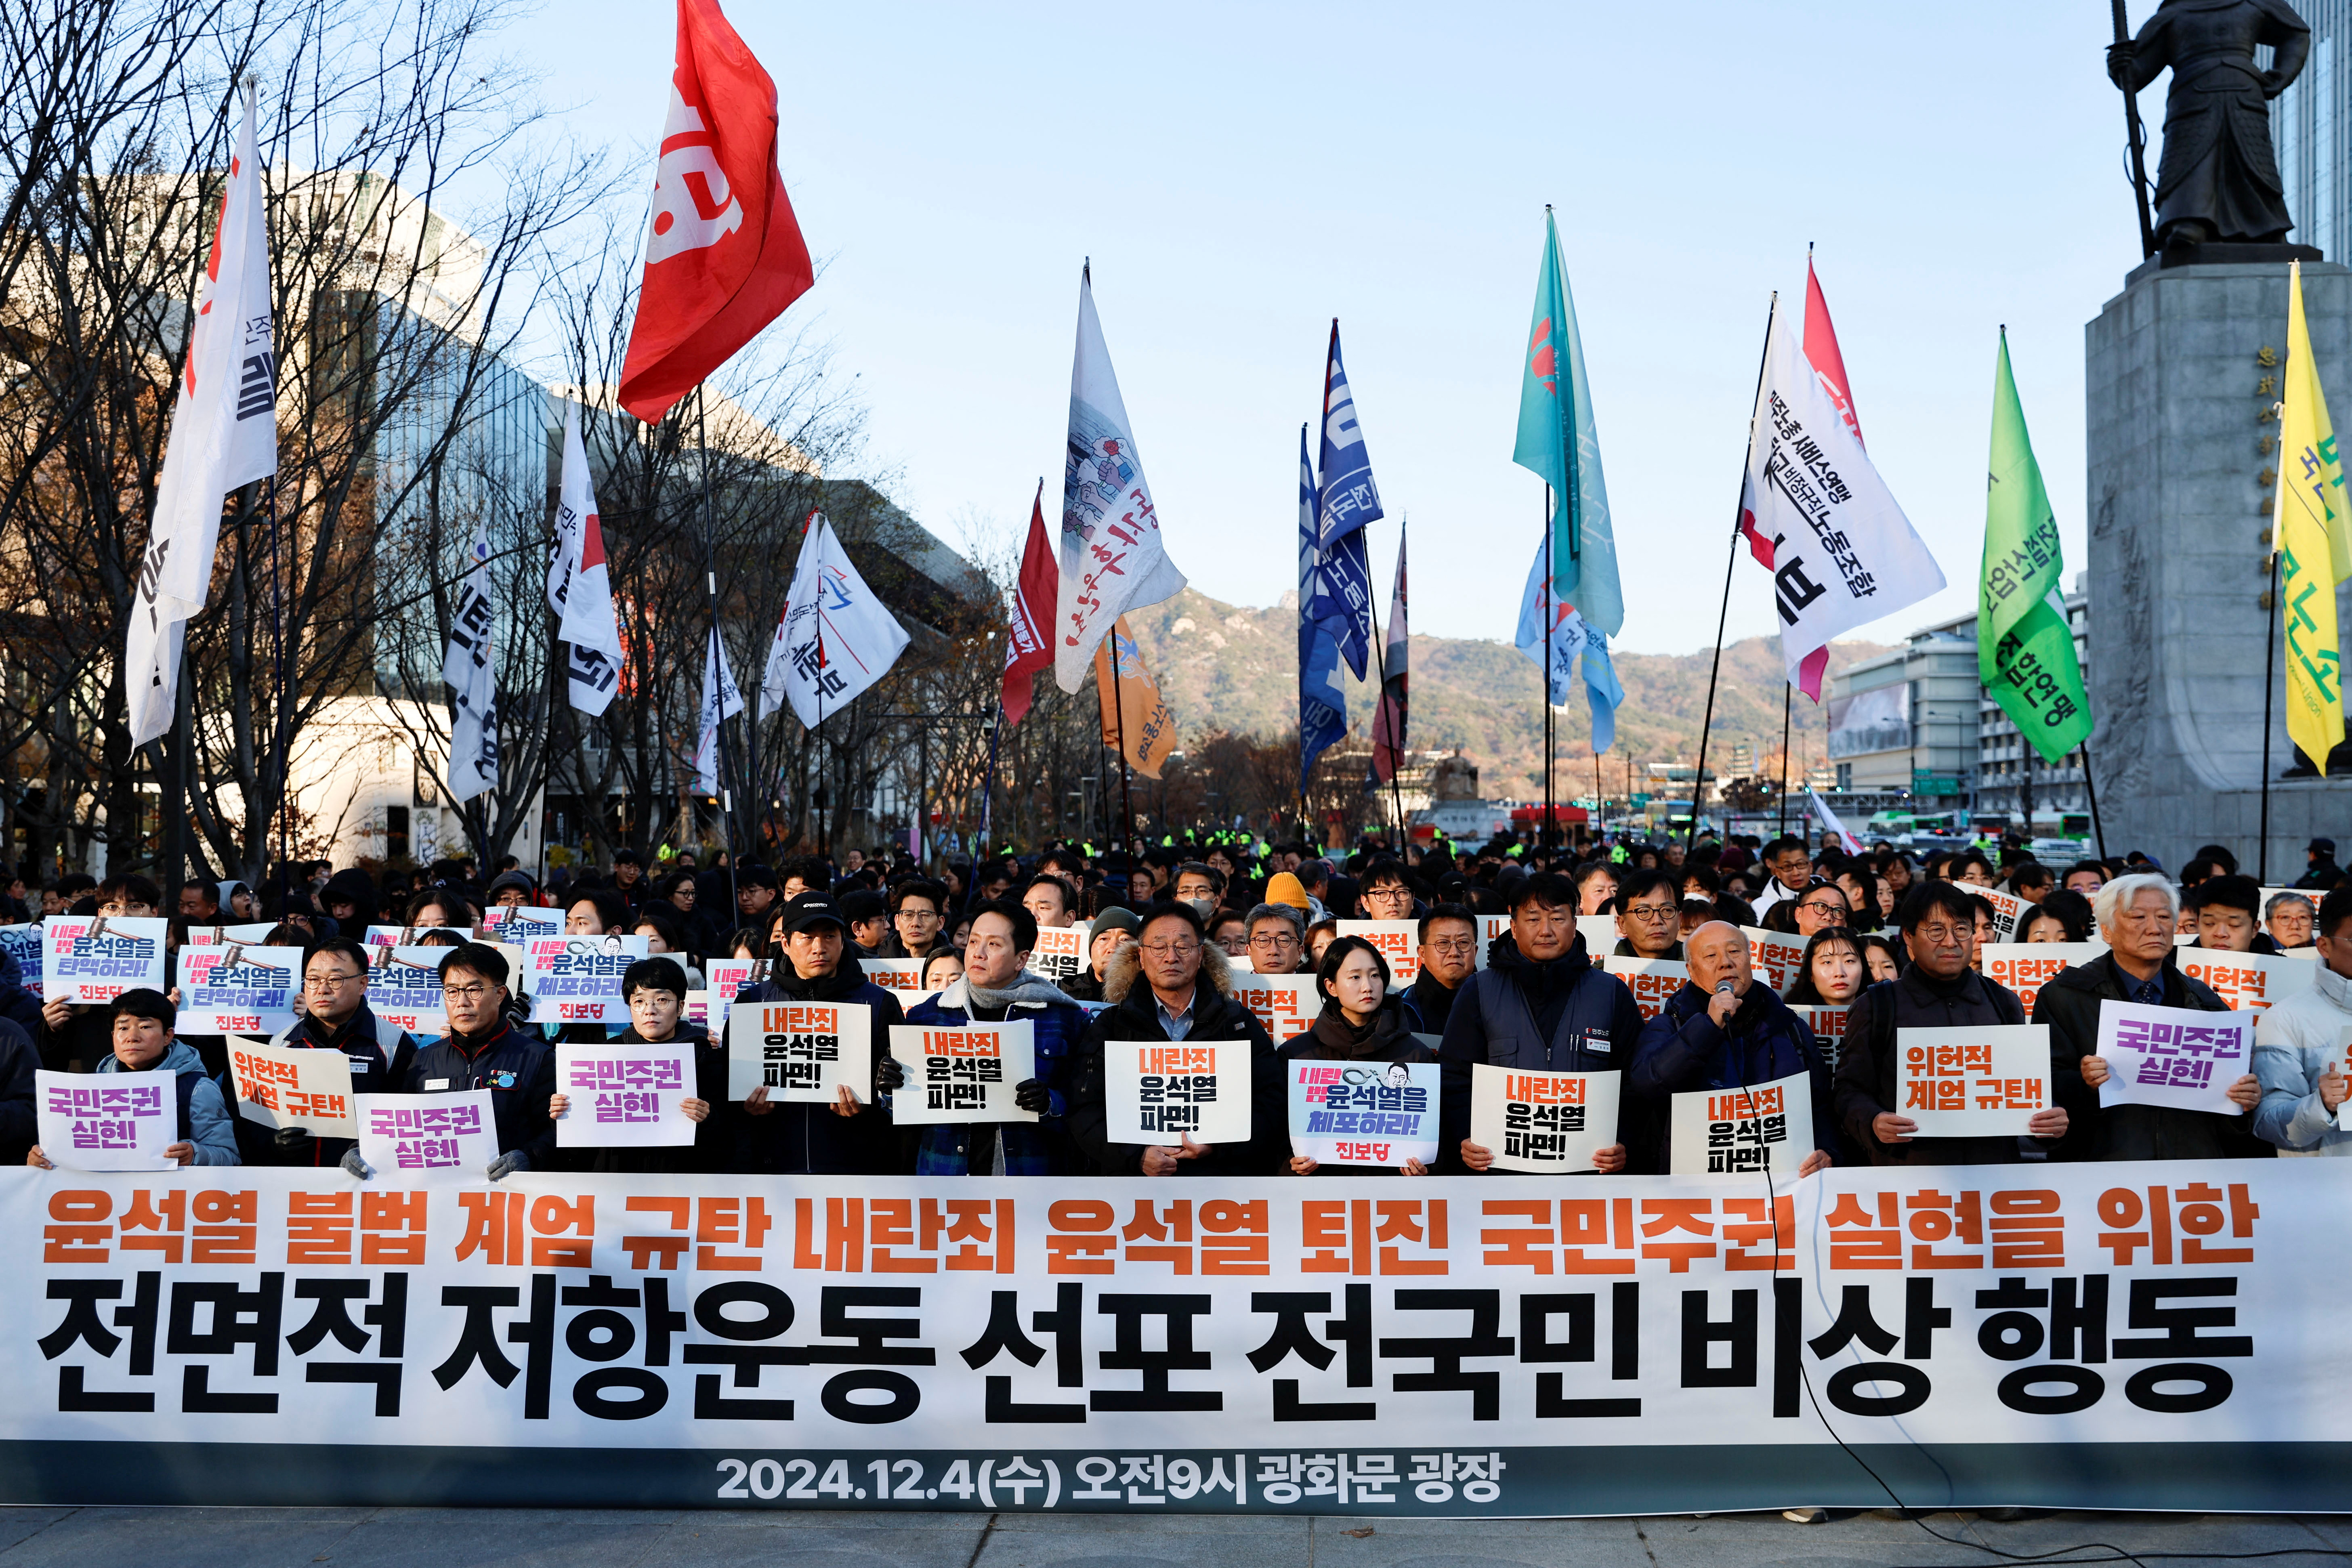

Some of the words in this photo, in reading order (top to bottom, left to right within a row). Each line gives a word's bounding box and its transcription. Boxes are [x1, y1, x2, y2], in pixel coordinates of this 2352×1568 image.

[1792, 435, 1852, 504] 서비스연맹
[50, 925, 86, 938] 내란
[55, 940, 72, 954] 범
[73, 938, 155, 959] 윤석열을
[185, 954, 222, 968] 내란
[531, 941, 567, 955] 내란
[57, 957, 148, 977] 탄핵하라!
[190, 970, 208, 984] 범
[208, 967, 291, 989] 윤석열을
[536, 956, 554, 970] 범
[552, 955, 636, 976] 윤석열을
[713, 969, 748, 983] 내란
[193, 988, 285, 1008] 탄핵하라!
[560, 1003, 605, 1018] 진보당
[216, 1016, 261, 1032] 진보당
[763, 1008, 838, 1034] 내란죄
[763, 1034, 839, 1062] 윤석열
[923, 1032, 999, 1057] 내란죄
[2117, 1019, 2242, 1058] 국민주권
[234, 1051, 299, 1089] 위헌적
[926, 1058, 1002, 1083] 윤석열
[1139, 1048, 1216, 1075] 내란죄
[1906, 1045, 1992, 1077] 위헌적
[2136, 1057, 2213, 1089] 실현!
[570, 1059, 682, 1091] 국민주권
[763, 1062, 821, 1089] 파면!
[1298, 1067, 1342, 1085] 내란
[48, 1086, 161, 1118] 국민주권
[240, 1077, 279, 1111] 계엄
[286, 1092, 347, 1119] 규탄!
[928, 1084, 986, 1110] 파면!
[1140, 1077, 1216, 1102] 윤석열
[1306, 1086, 1327, 1103] 범
[1326, 1085, 1427, 1113] 윤석열을
[1506, 1075, 1586, 1105] 내란죄
[1708, 1085, 1783, 1121] 내란죄
[1906, 1079, 1966, 1111] 계엄
[1975, 1079, 2042, 1110] 규탄!
[370, 1105, 481, 1137] 국민주권
[595, 1092, 659, 1123] 실현!
[1140, 1105, 1199, 1132] 파면!
[1506, 1103, 1586, 1132] 윤석열
[71, 1120, 137, 1150] 실현!
[1307, 1110, 1420, 1136] 체포하라!
[1708, 1114, 1787, 1148] 윤석열
[395, 1140, 461, 1169] 실현!
[1336, 1142, 1390, 1162] 진보당
[1505, 1134, 1565, 1161] 파면!
[1707, 1146, 1770, 1173] 파면!
[44, 1189, 258, 1264] 윤석열
[286, 1190, 428, 1265] 불법
[454, 1191, 595, 1269] 계엄
[622, 1196, 772, 1272] 규탄
[794, 1197, 1015, 1275] 내란죄
[1046, 1199, 1270, 1276] 윤석열
[1300, 1199, 1449, 1276] 퇴진
[1480, 1194, 1796, 1275] 국민주권
[1824, 1188, 2065, 1270] 실현을
[2096, 1182, 2260, 1266] 위한
[36, 1270, 409, 1418] 전면적
[430, 1273, 937, 1425] 저항운동
[958, 1282, 1224, 1424] 선포
[1245, 1281, 1642, 1423] 전국민
[1680, 1276, 1952, 1419] 비상
[1975, 1273, 2254, 1415] 행동
[716, 1455, 1061, 1509] 2024.12.4(수)
[1072, 1454, 1247, 1505] 오전9시
[1256, 1452, 1402, 1505] 광화문
[1408, 1451, 1507, 1504] 광장
